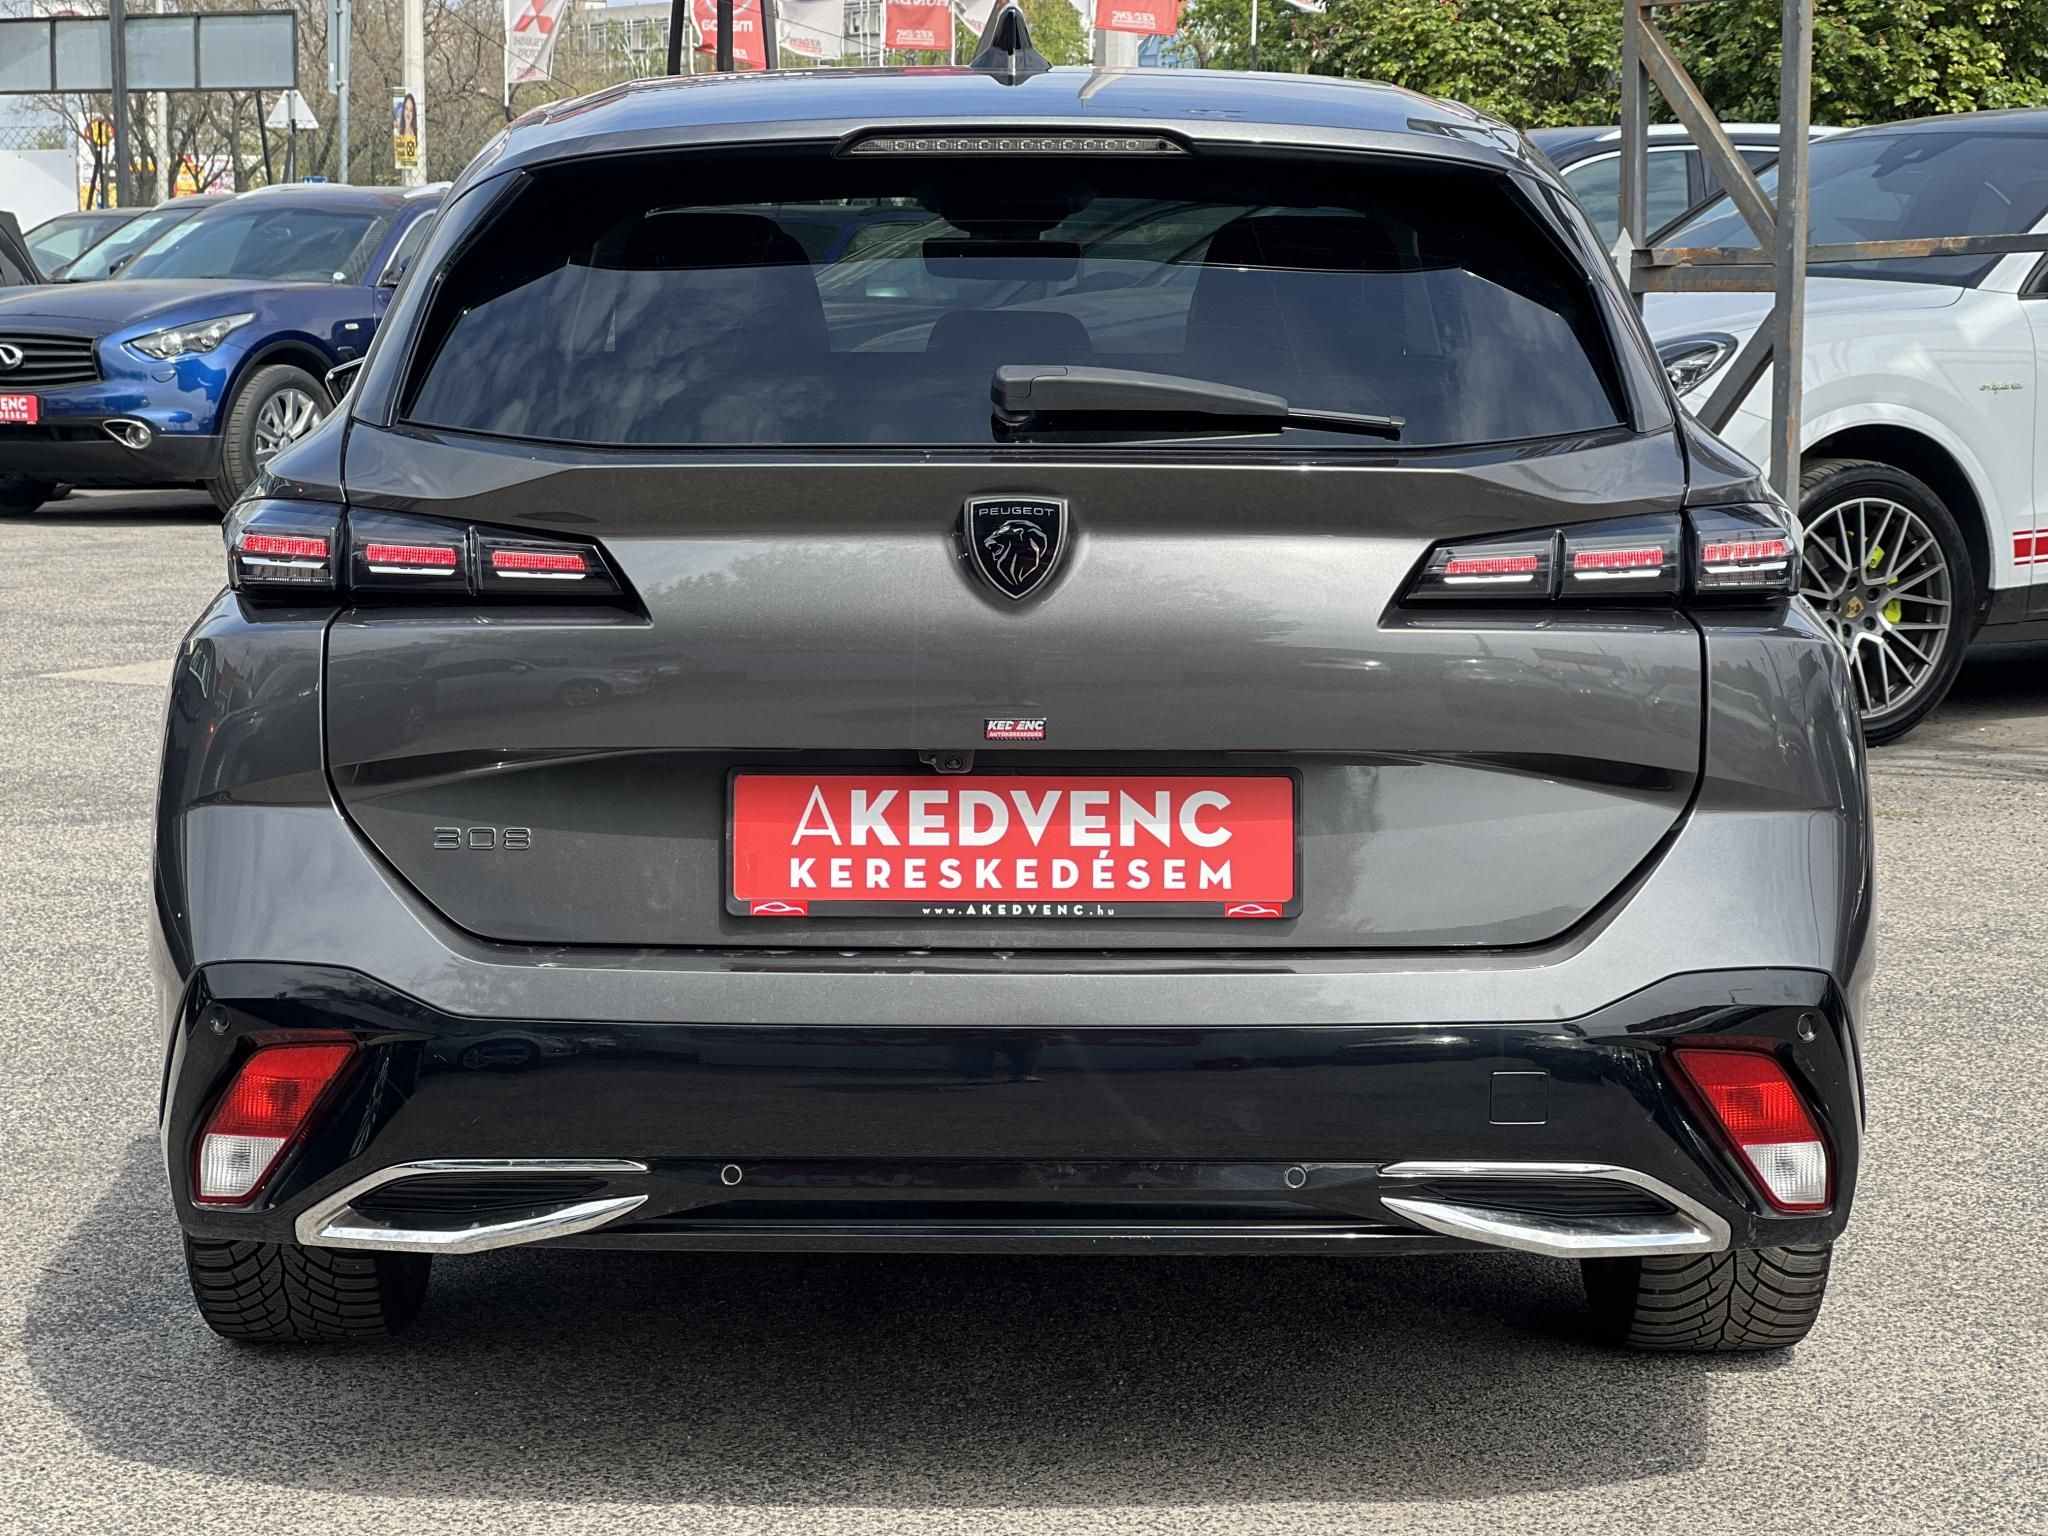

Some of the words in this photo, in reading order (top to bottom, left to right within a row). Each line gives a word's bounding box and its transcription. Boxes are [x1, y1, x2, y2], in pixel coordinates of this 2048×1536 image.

[978, 506, 1055, 517] PEUGEOT
[433, 826, 531, 850] 308
[789, 850, 1233, 889] KERESKEDÉSEM
[922, 904, 1115, 917] www.AKEDVENC.hu
